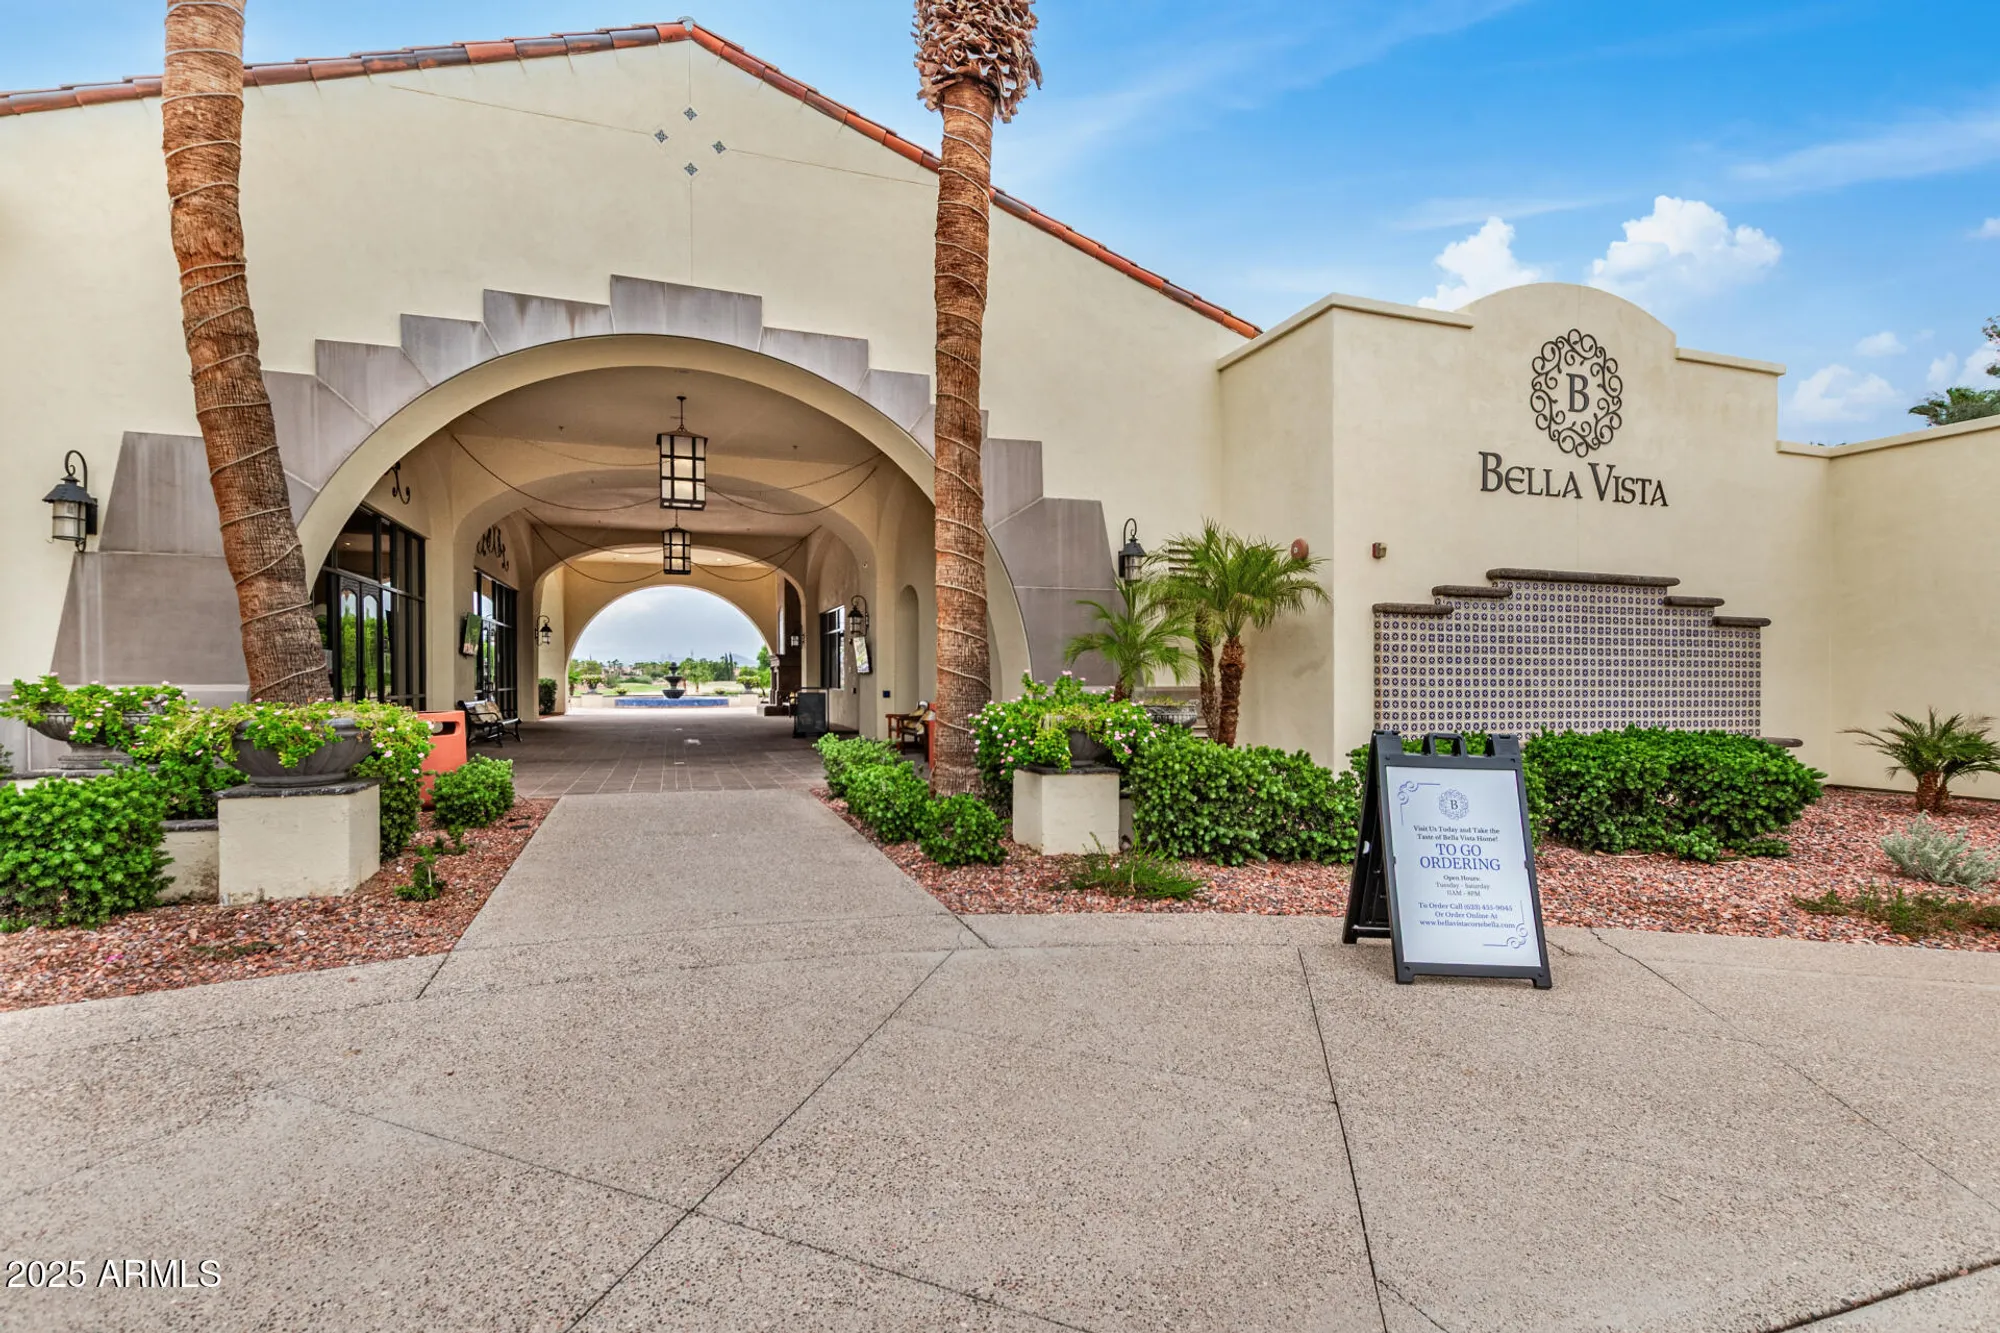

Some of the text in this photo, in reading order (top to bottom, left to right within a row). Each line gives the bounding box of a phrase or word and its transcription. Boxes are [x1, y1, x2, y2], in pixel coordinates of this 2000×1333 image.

[1566, 373, 1590, 413] B
[1478, 451, 1669, 507] BELLA VISTA
[1450, 800, 1459, 810] B
[1439, 826, 1459, 834] Today
[1435, 843, 1482, 857] TO GO
[1419, 856, 1501, 871] ORDERING
[1435, 881, 1460, 889] Tuesday
[1428, 902, 1448, 910] Order
